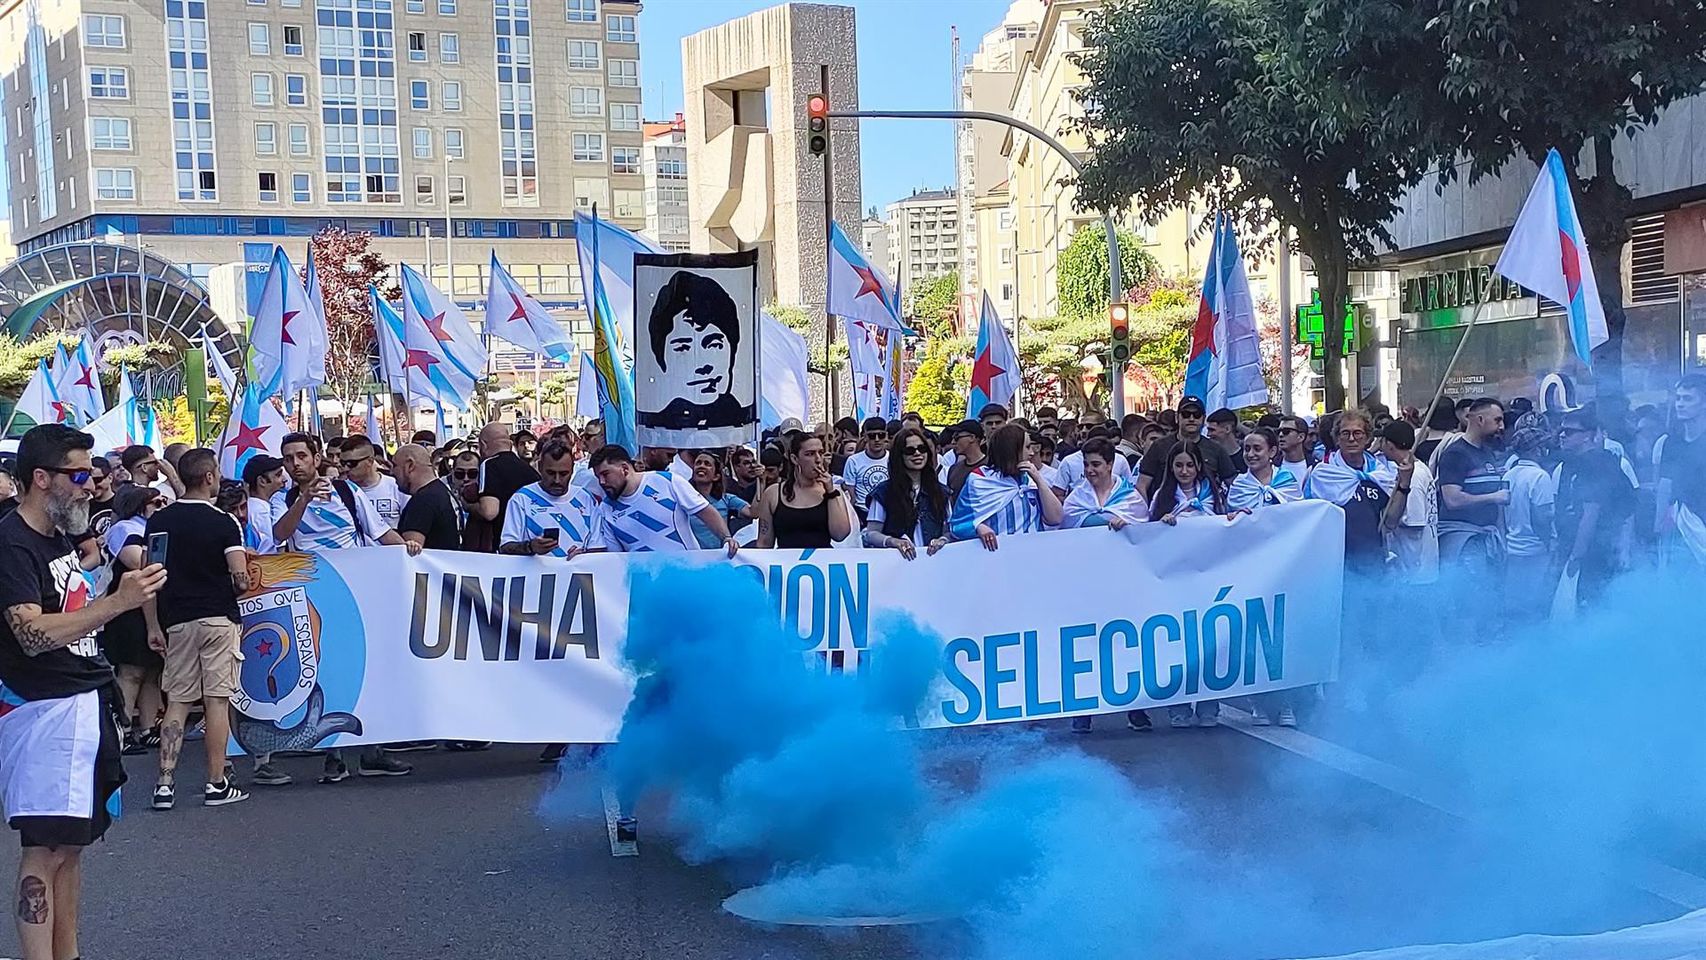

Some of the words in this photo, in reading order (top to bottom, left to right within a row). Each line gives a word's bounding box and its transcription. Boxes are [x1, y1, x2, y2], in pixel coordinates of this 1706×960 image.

[239, 597, 264, 615] TOS
[294, 614, 316, 689] ESCRAVOS
[408, 572, 601, 661] UNHA
[941, 585, 1286, 725] SELECCIÓN
